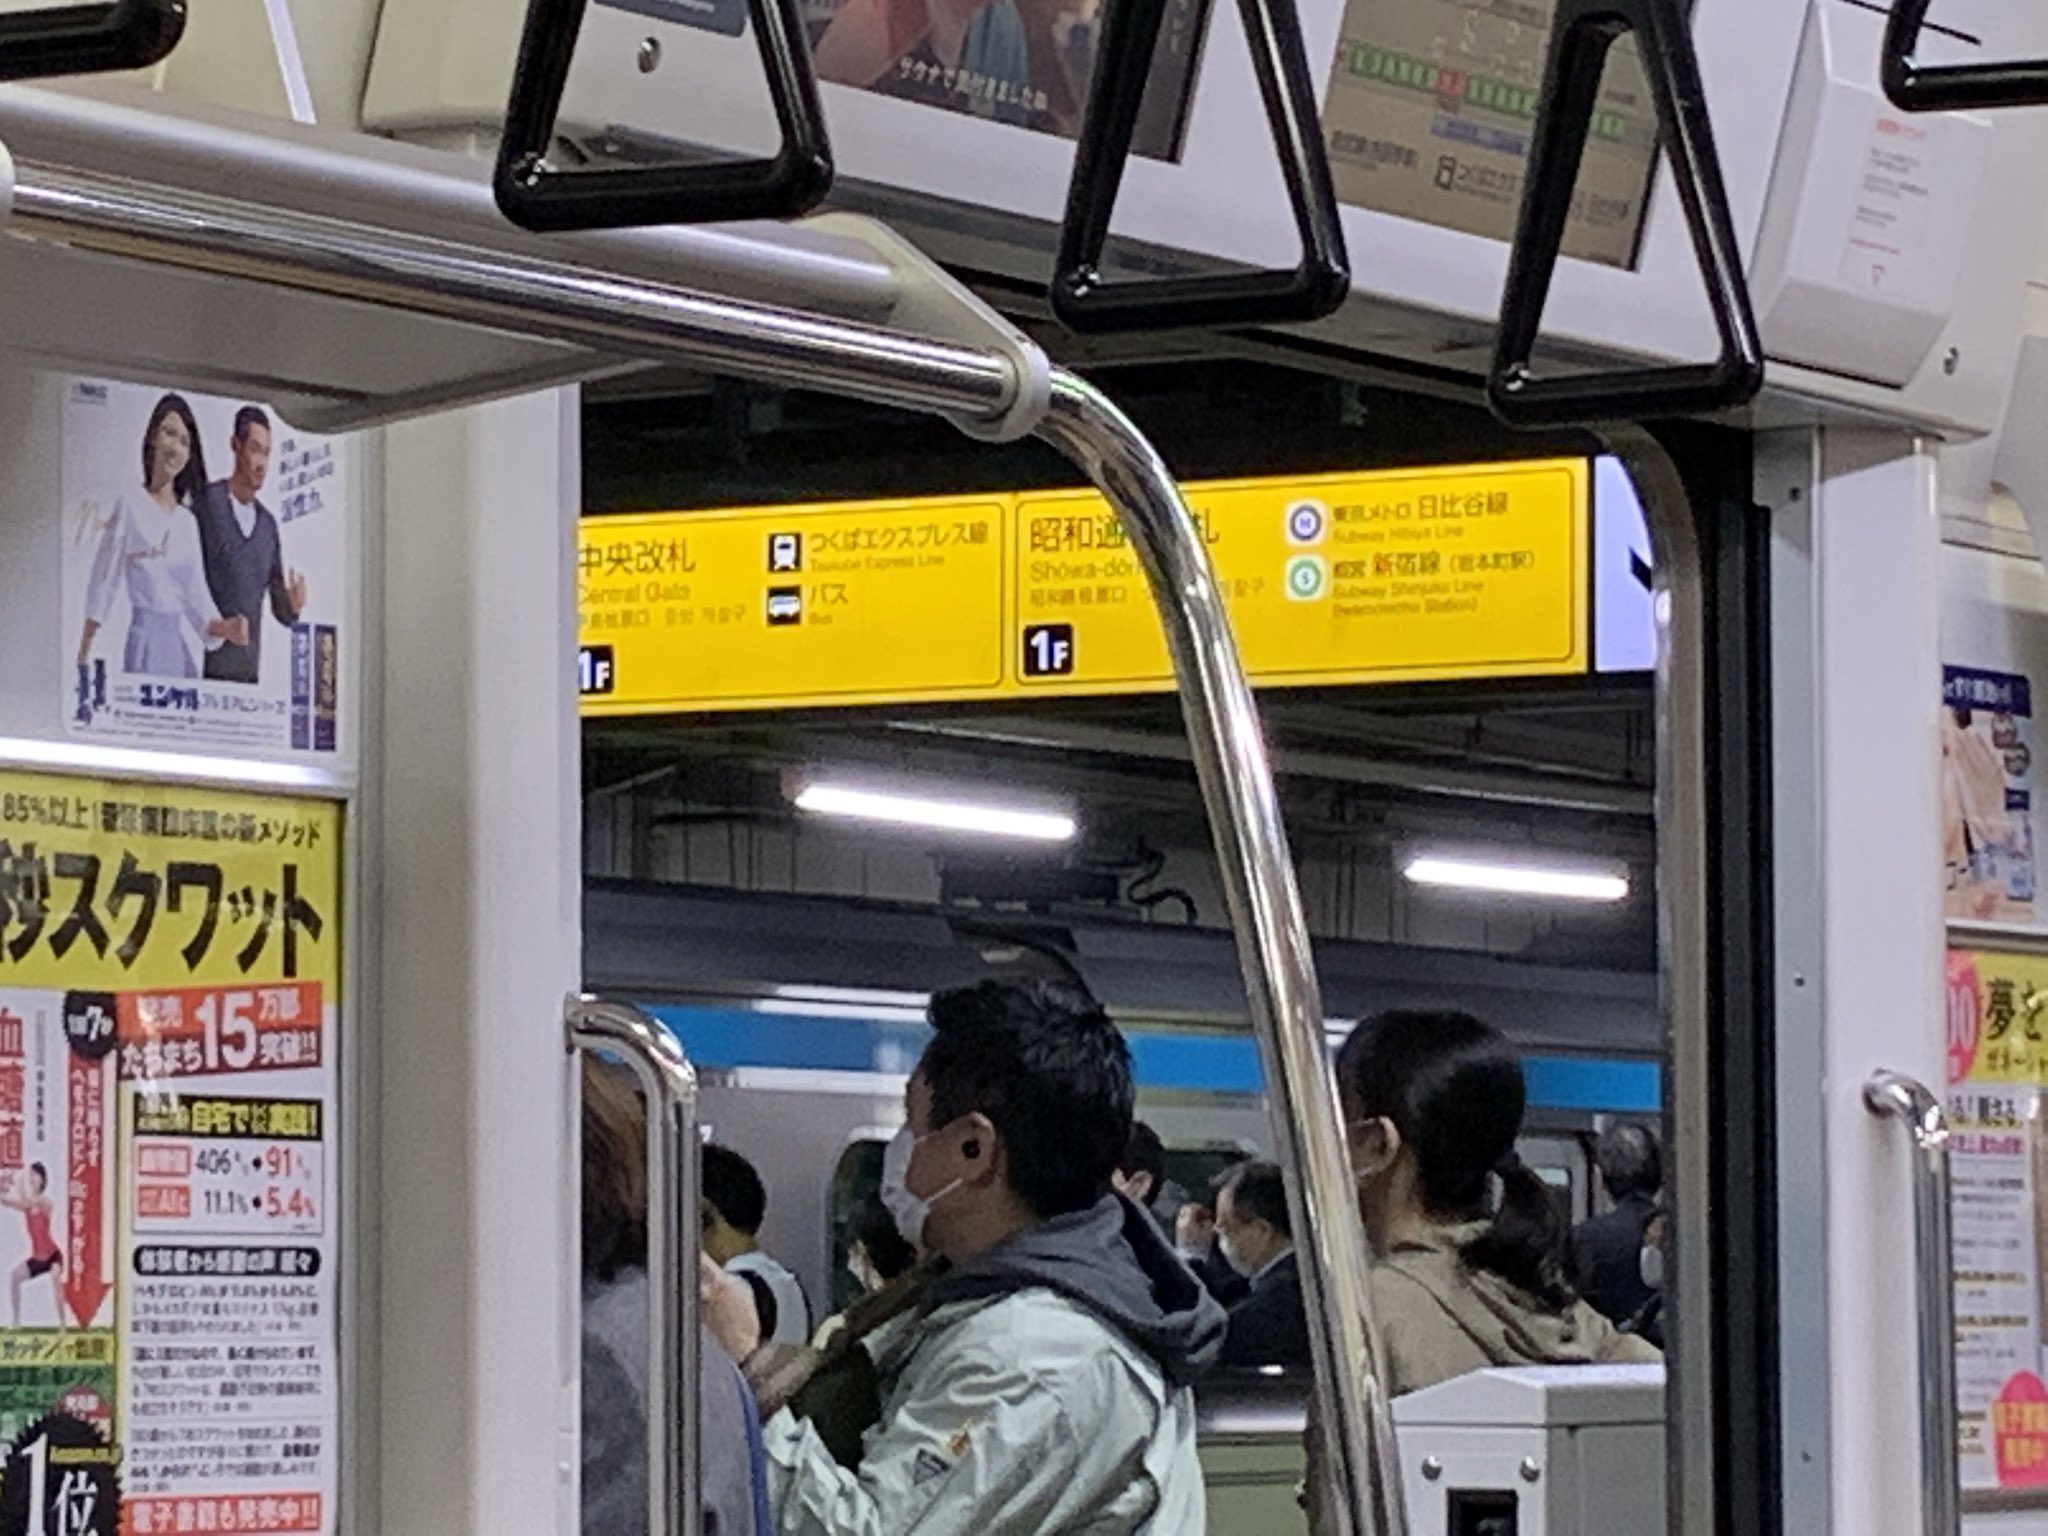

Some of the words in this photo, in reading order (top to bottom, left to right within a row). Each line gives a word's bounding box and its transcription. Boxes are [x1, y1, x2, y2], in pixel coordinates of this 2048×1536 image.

[1418, 492, 1509, 520] 日比谷線
[810, 521, 989, 552] つくばエクスプレス線
[579, 537, 697, 578] 中央改札
[809, 584, 848, 605] バス
[1031, 631, 1068, 672] 1F
[195, 992, 257, 1068] 15
